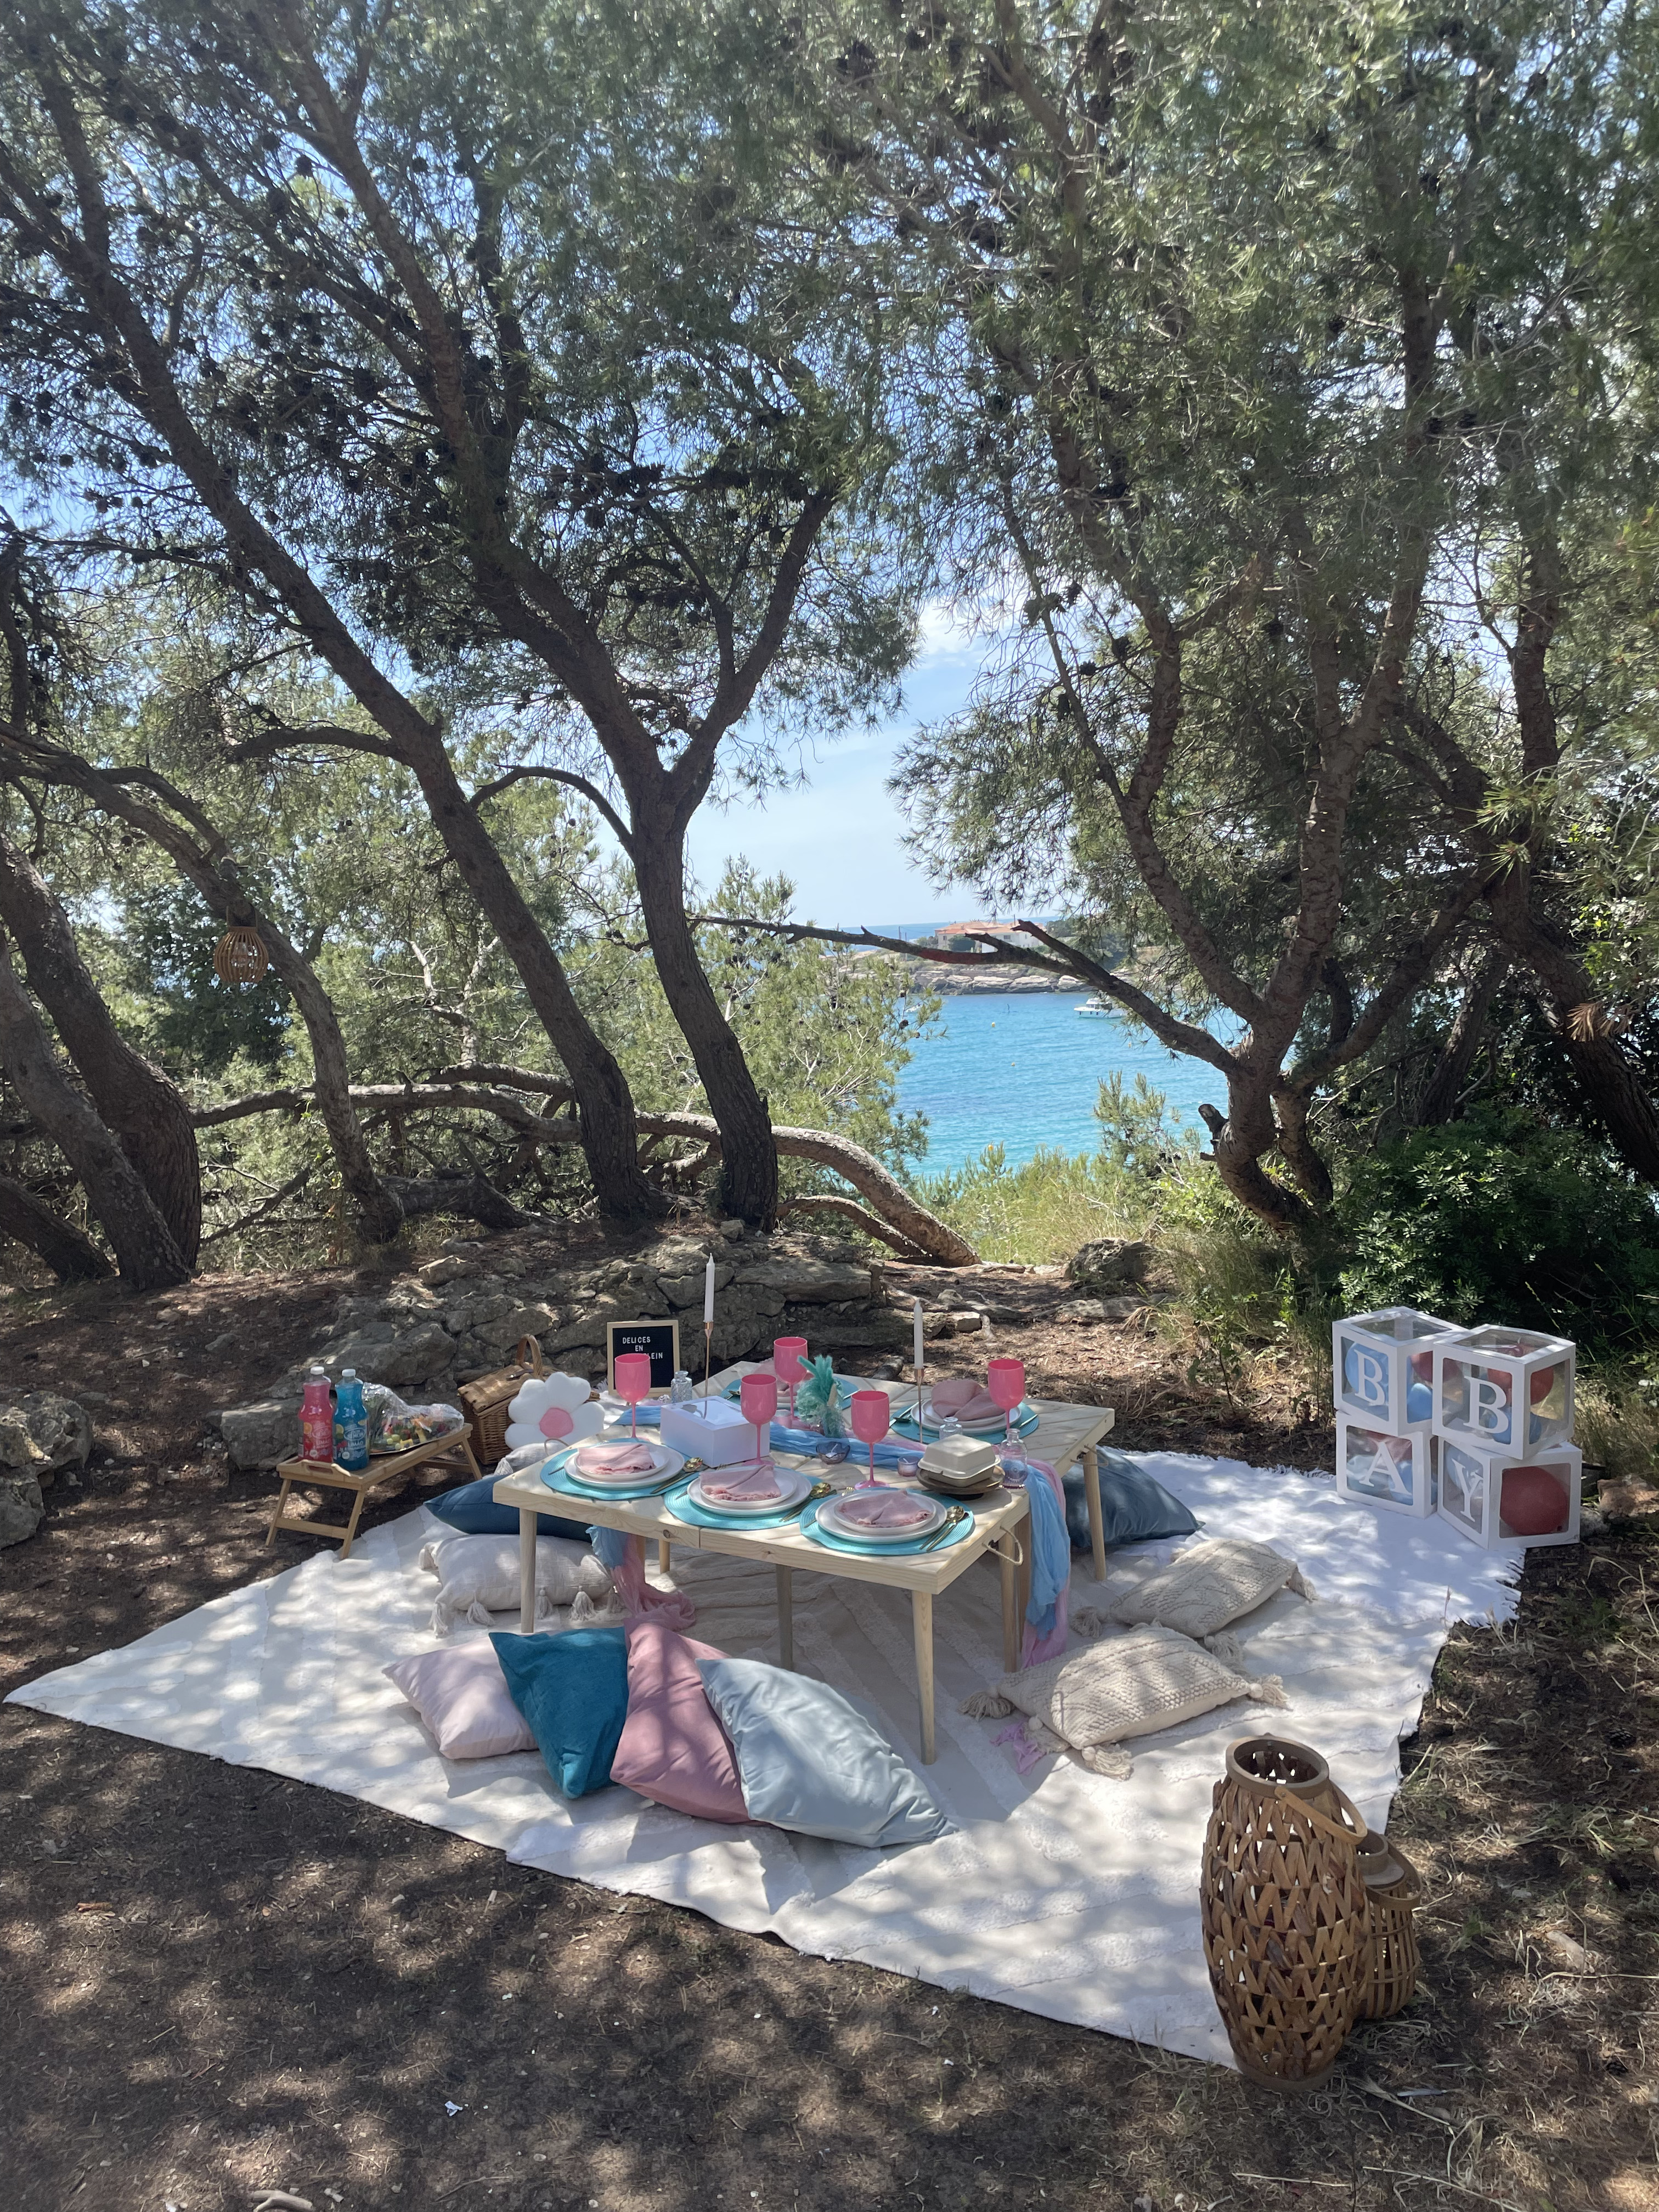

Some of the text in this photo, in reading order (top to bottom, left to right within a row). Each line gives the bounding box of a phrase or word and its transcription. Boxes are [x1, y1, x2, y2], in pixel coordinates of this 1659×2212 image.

[1353, 1348, 1385, 1406] B
[1463, 1375, 1509, 1434] B
[1359, 1442, 1412, 1496] A
[1452, 1459, 1483, 1522] Y
